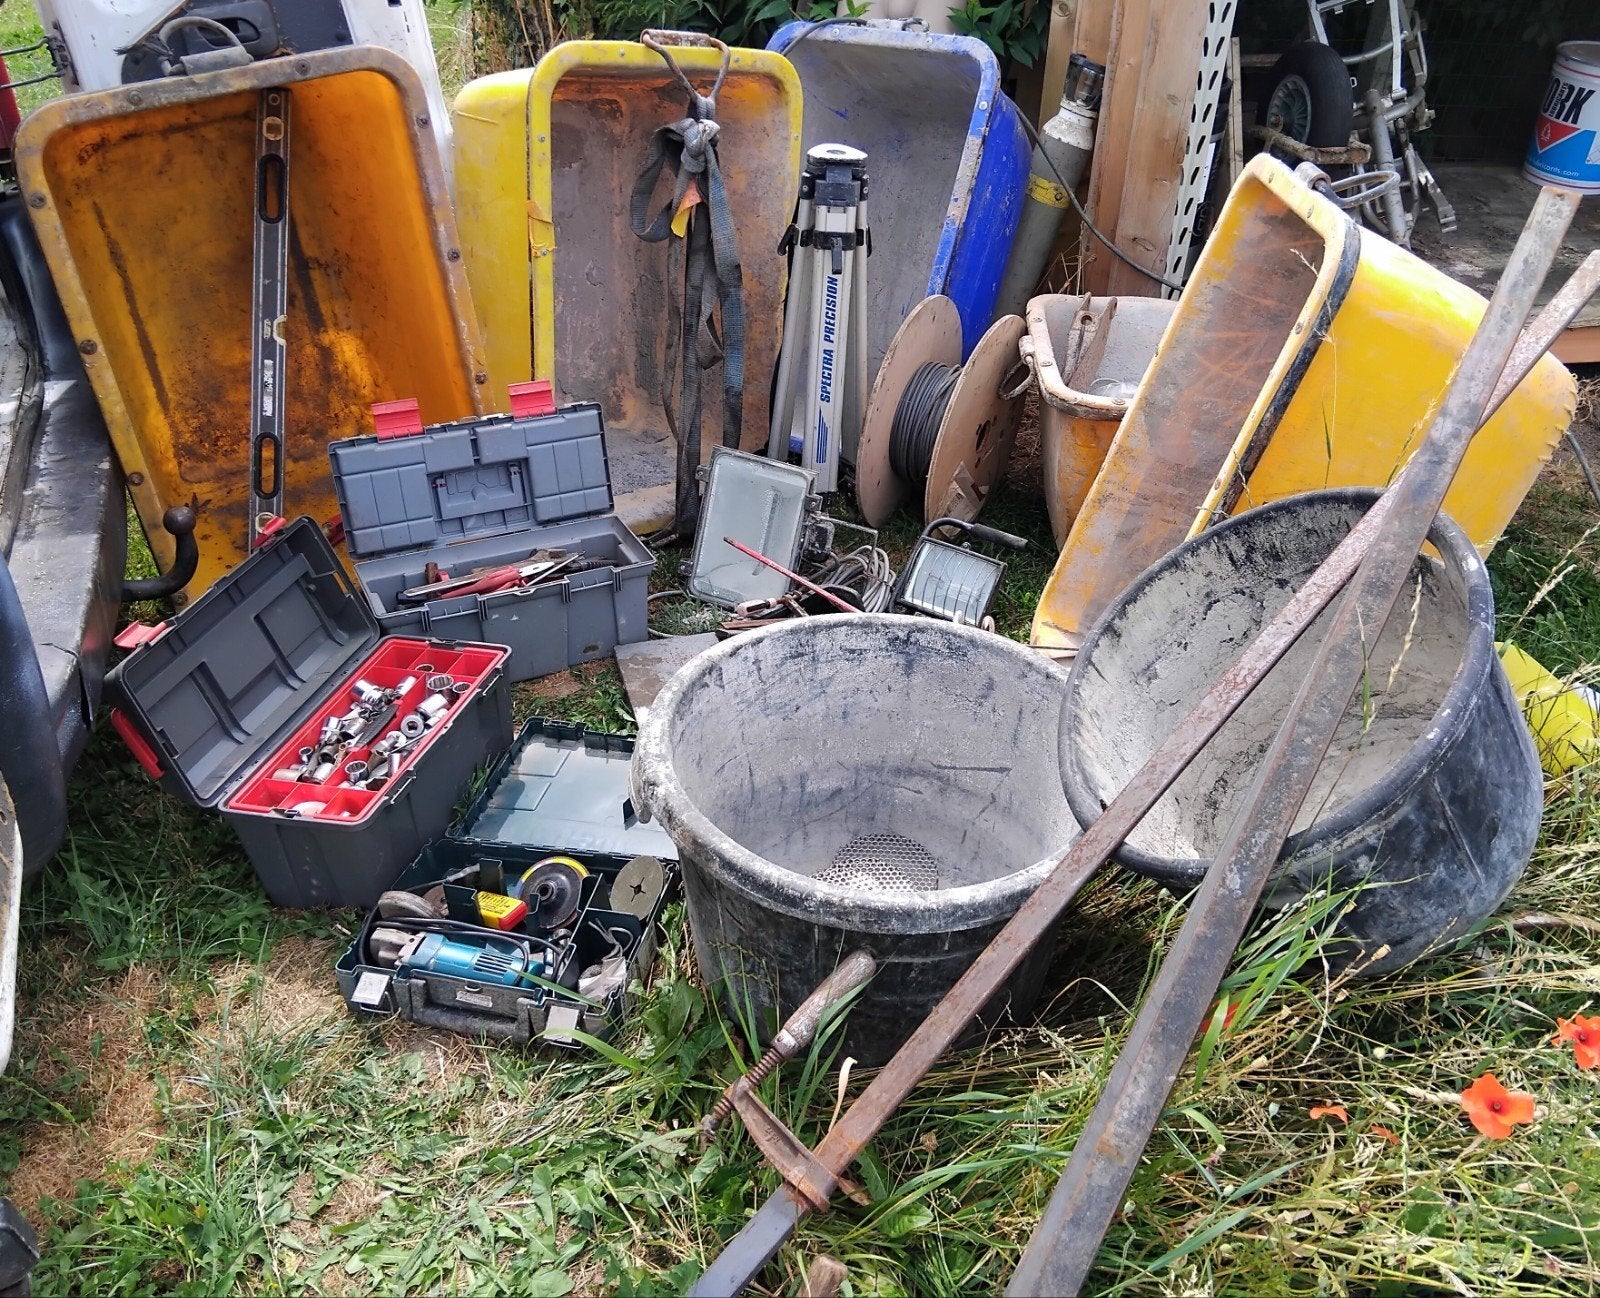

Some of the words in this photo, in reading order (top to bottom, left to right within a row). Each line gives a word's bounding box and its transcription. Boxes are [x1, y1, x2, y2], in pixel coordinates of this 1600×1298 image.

[1543, 77, 1596, 125] ORK
[824, 276, 838, 344] PRECISION
[820, 349, 834, 403] SPECTRA
